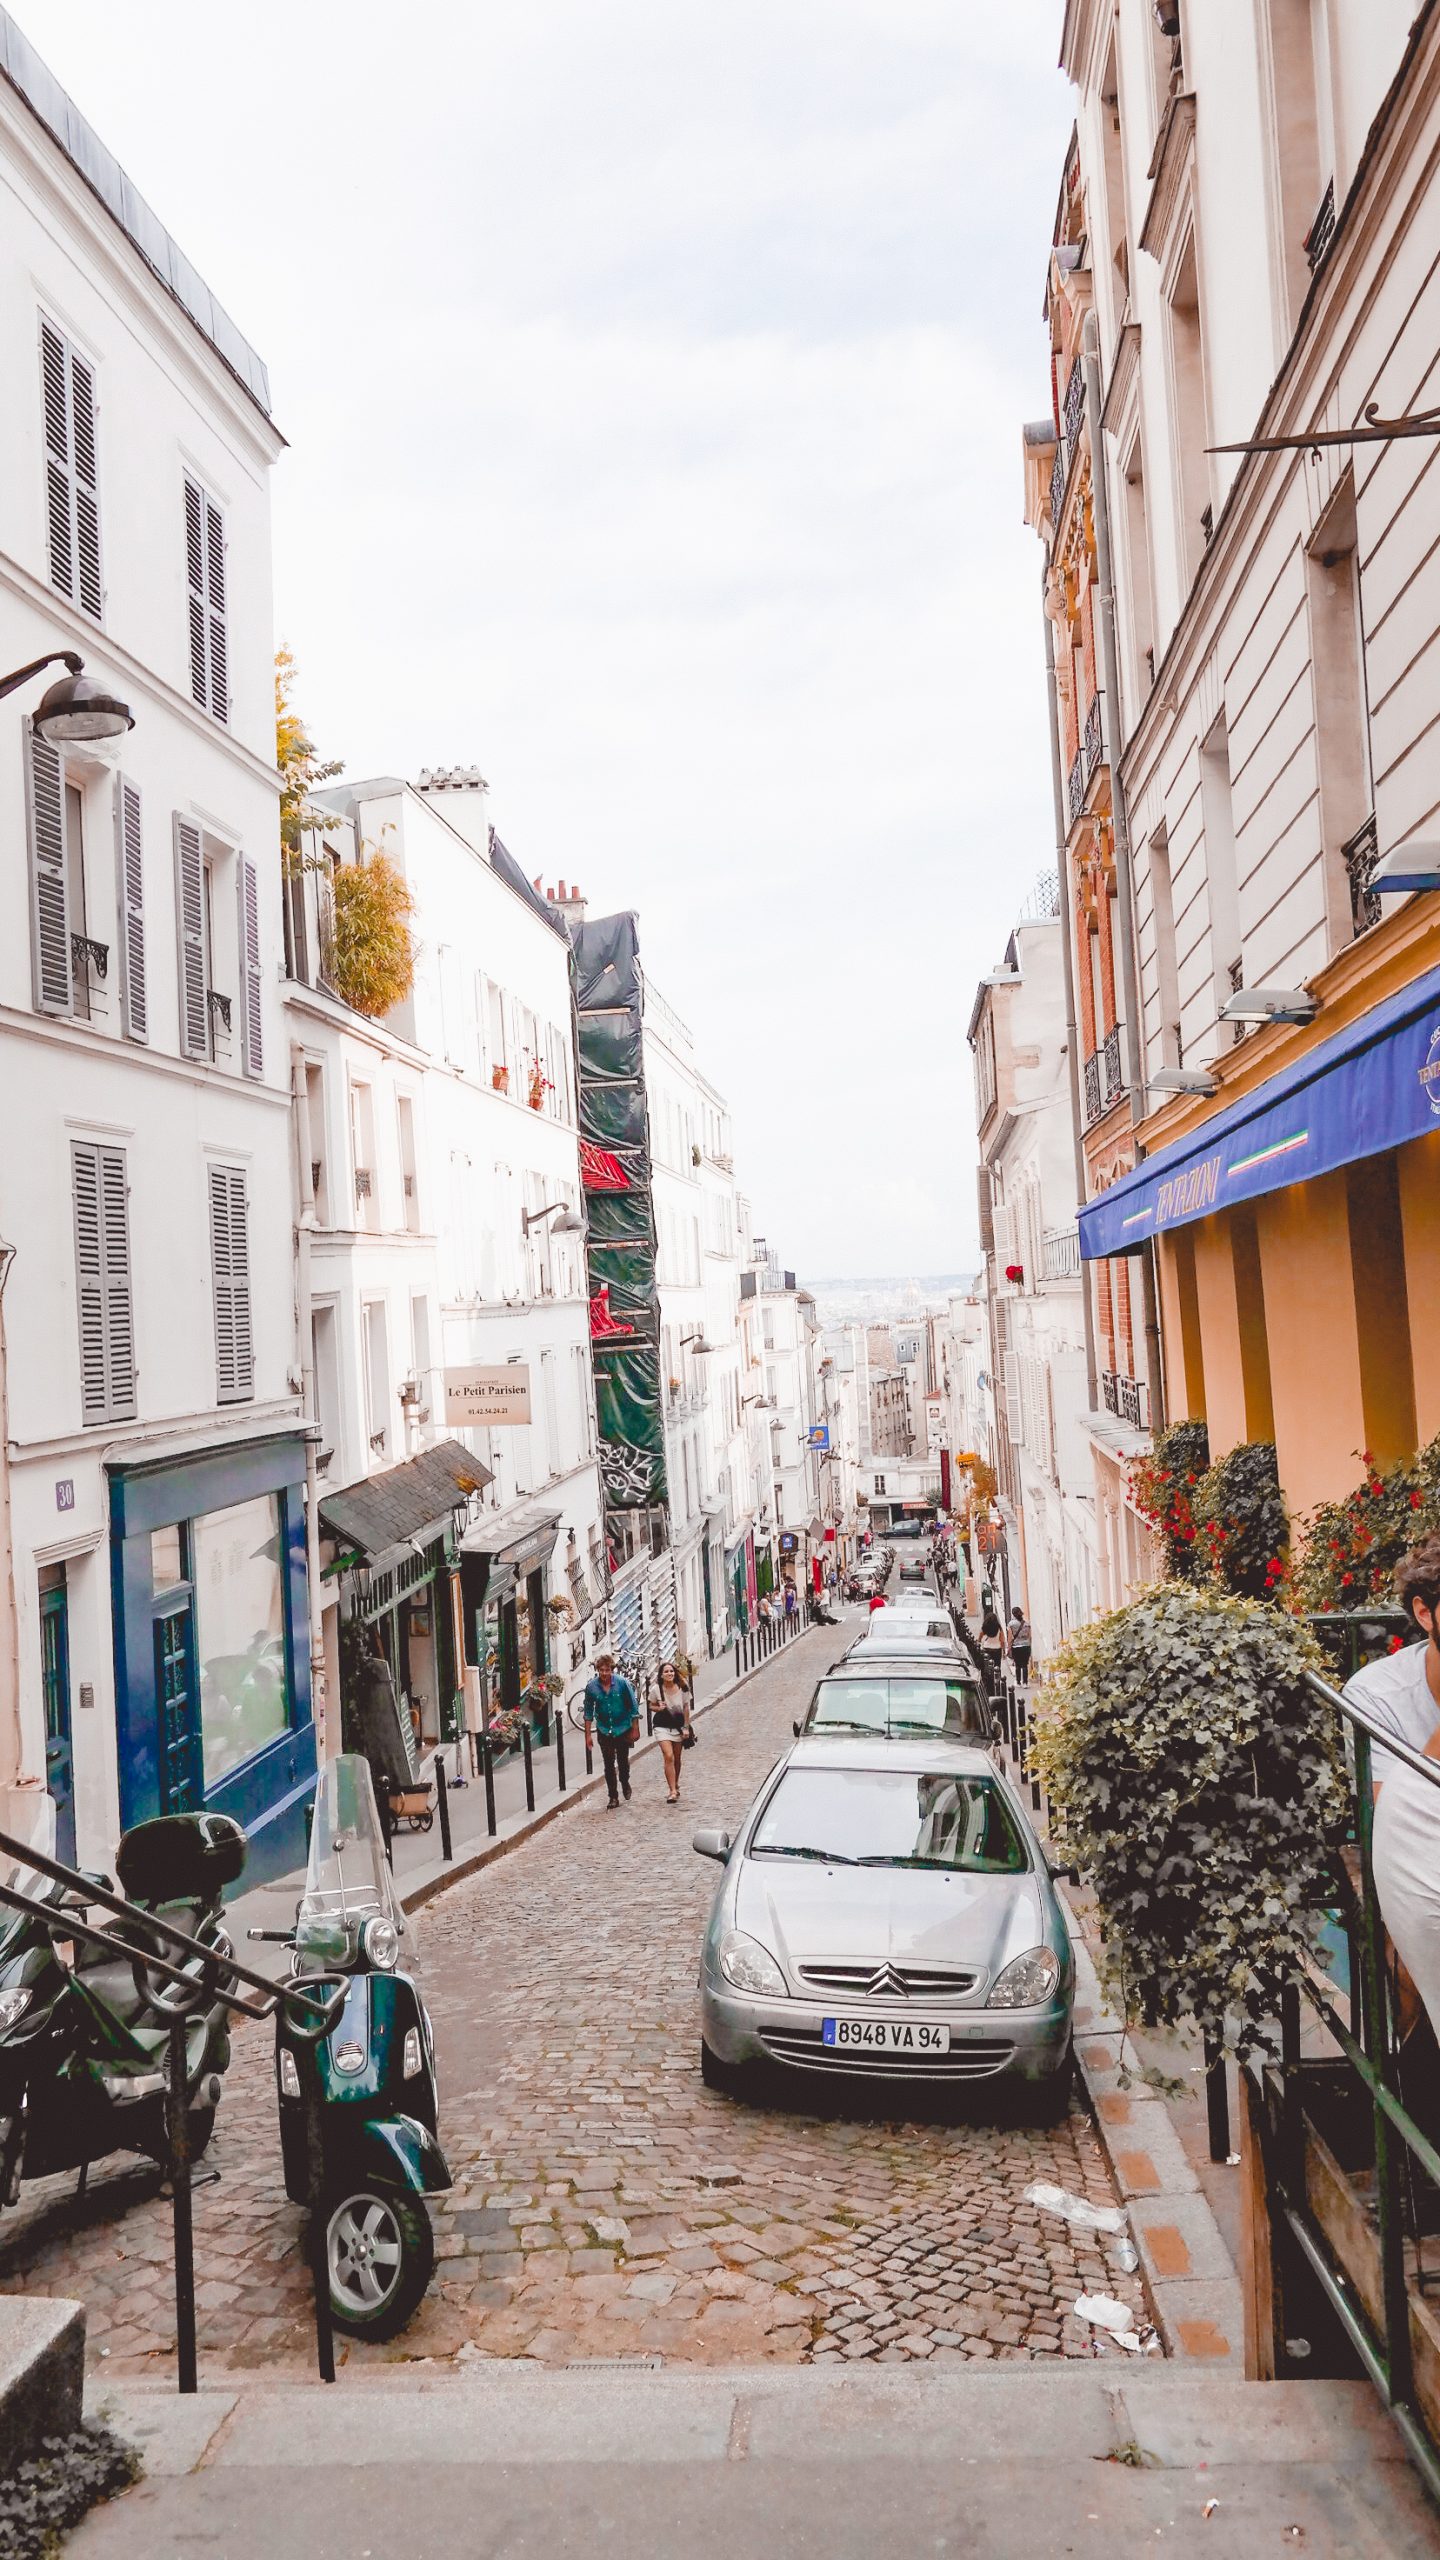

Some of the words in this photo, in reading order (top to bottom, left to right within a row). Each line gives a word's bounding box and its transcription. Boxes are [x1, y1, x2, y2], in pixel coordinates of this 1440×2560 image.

[1155, 1156, 1221, 1225] TENTAZIONI
[448, 1387, 461, 1397] Le
[463, 1386, 485, 1396] Petit
[488, 1384, 527, 1396] Parisien
[59, 1484, 72, 1507] 30
[978, 1535, 996, 1550] 21
[839, 2022, 886, 2045] 8948
[891, 2026, 914, 2047] VA
[918, 2027, 942, 2048] 94
